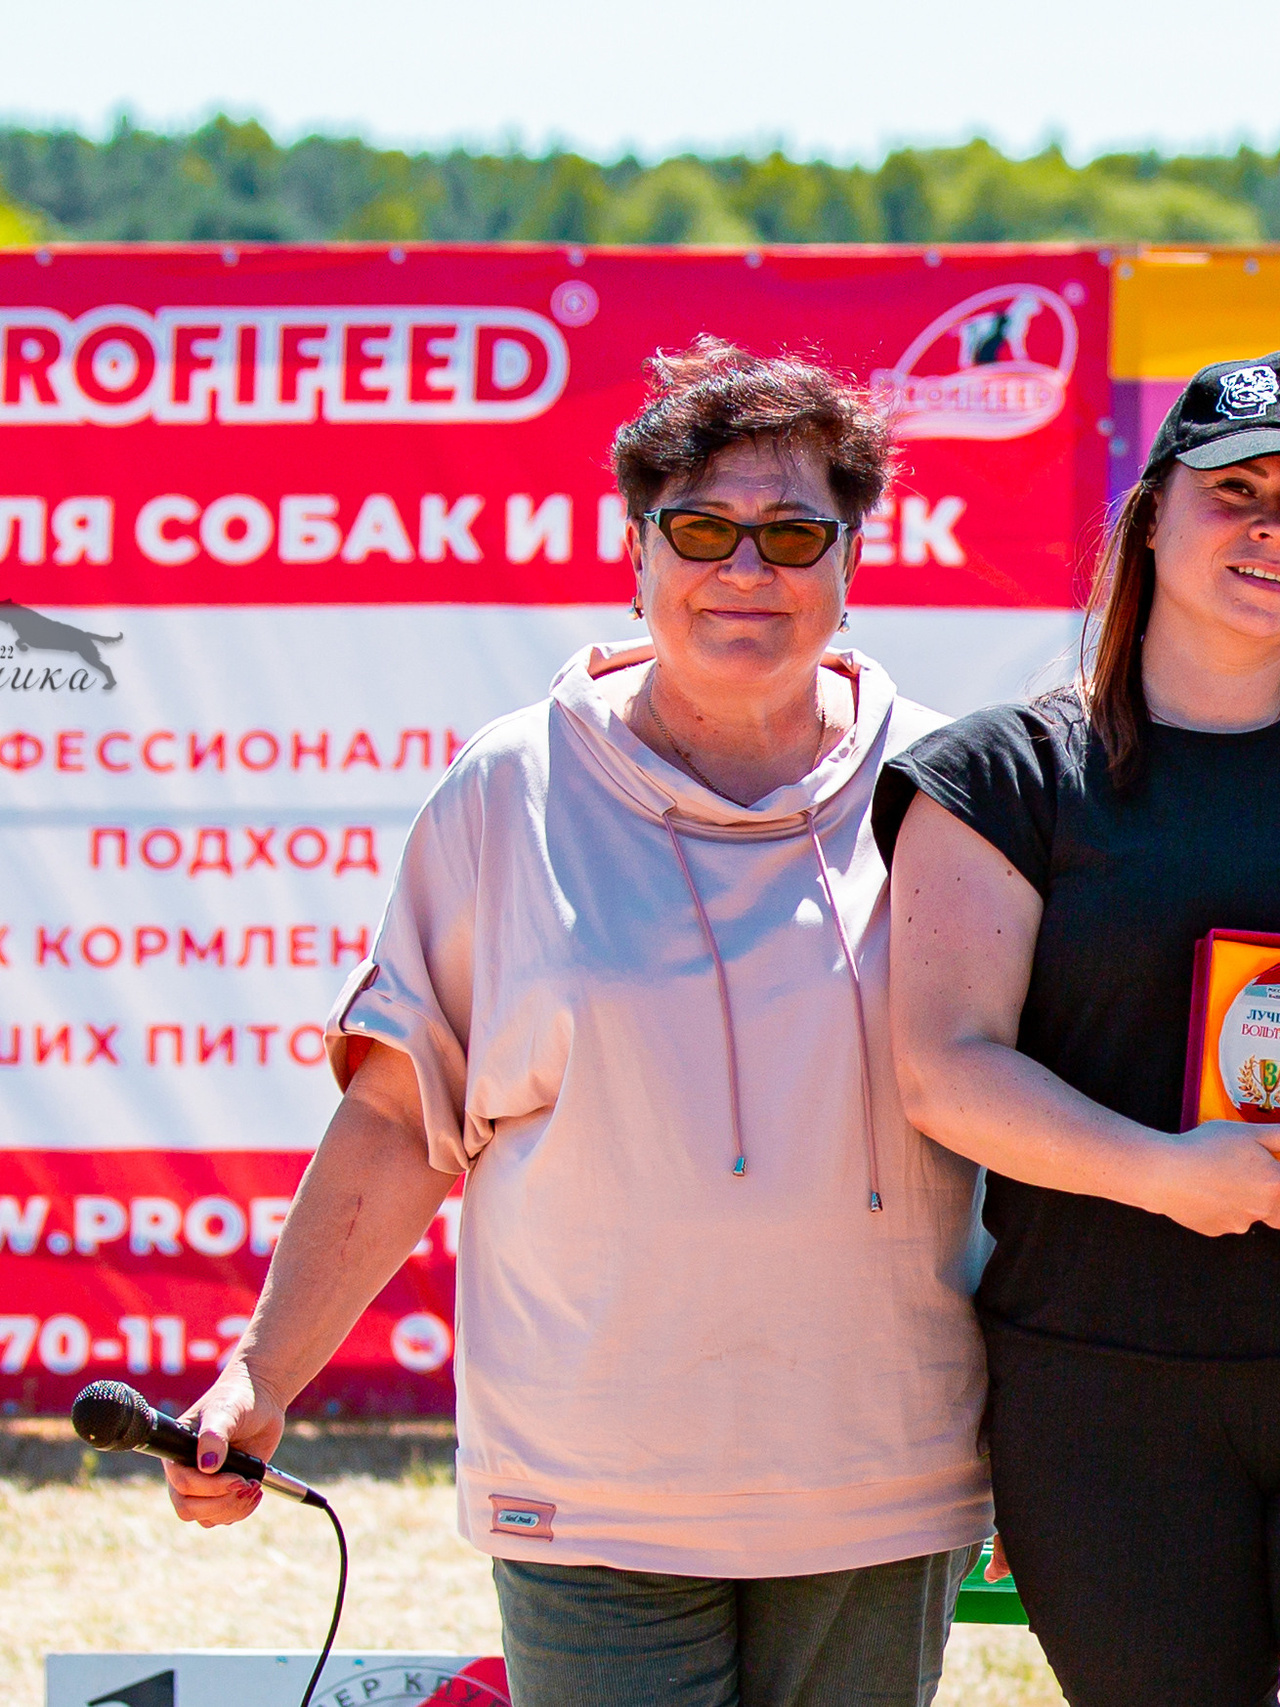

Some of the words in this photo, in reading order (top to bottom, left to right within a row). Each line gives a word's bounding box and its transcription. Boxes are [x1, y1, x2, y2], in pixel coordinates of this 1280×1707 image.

[135, 494, 484, 566] СОБАК
[505, 495, 573, 564] И
[89, 826, 380, 878] ПОДХОД
[36, 925, 369, 968] КОРМЛЕН
[146, 1023, 326, 1067] ПИТО
[1264, 1062, 1278, 1086] 3
